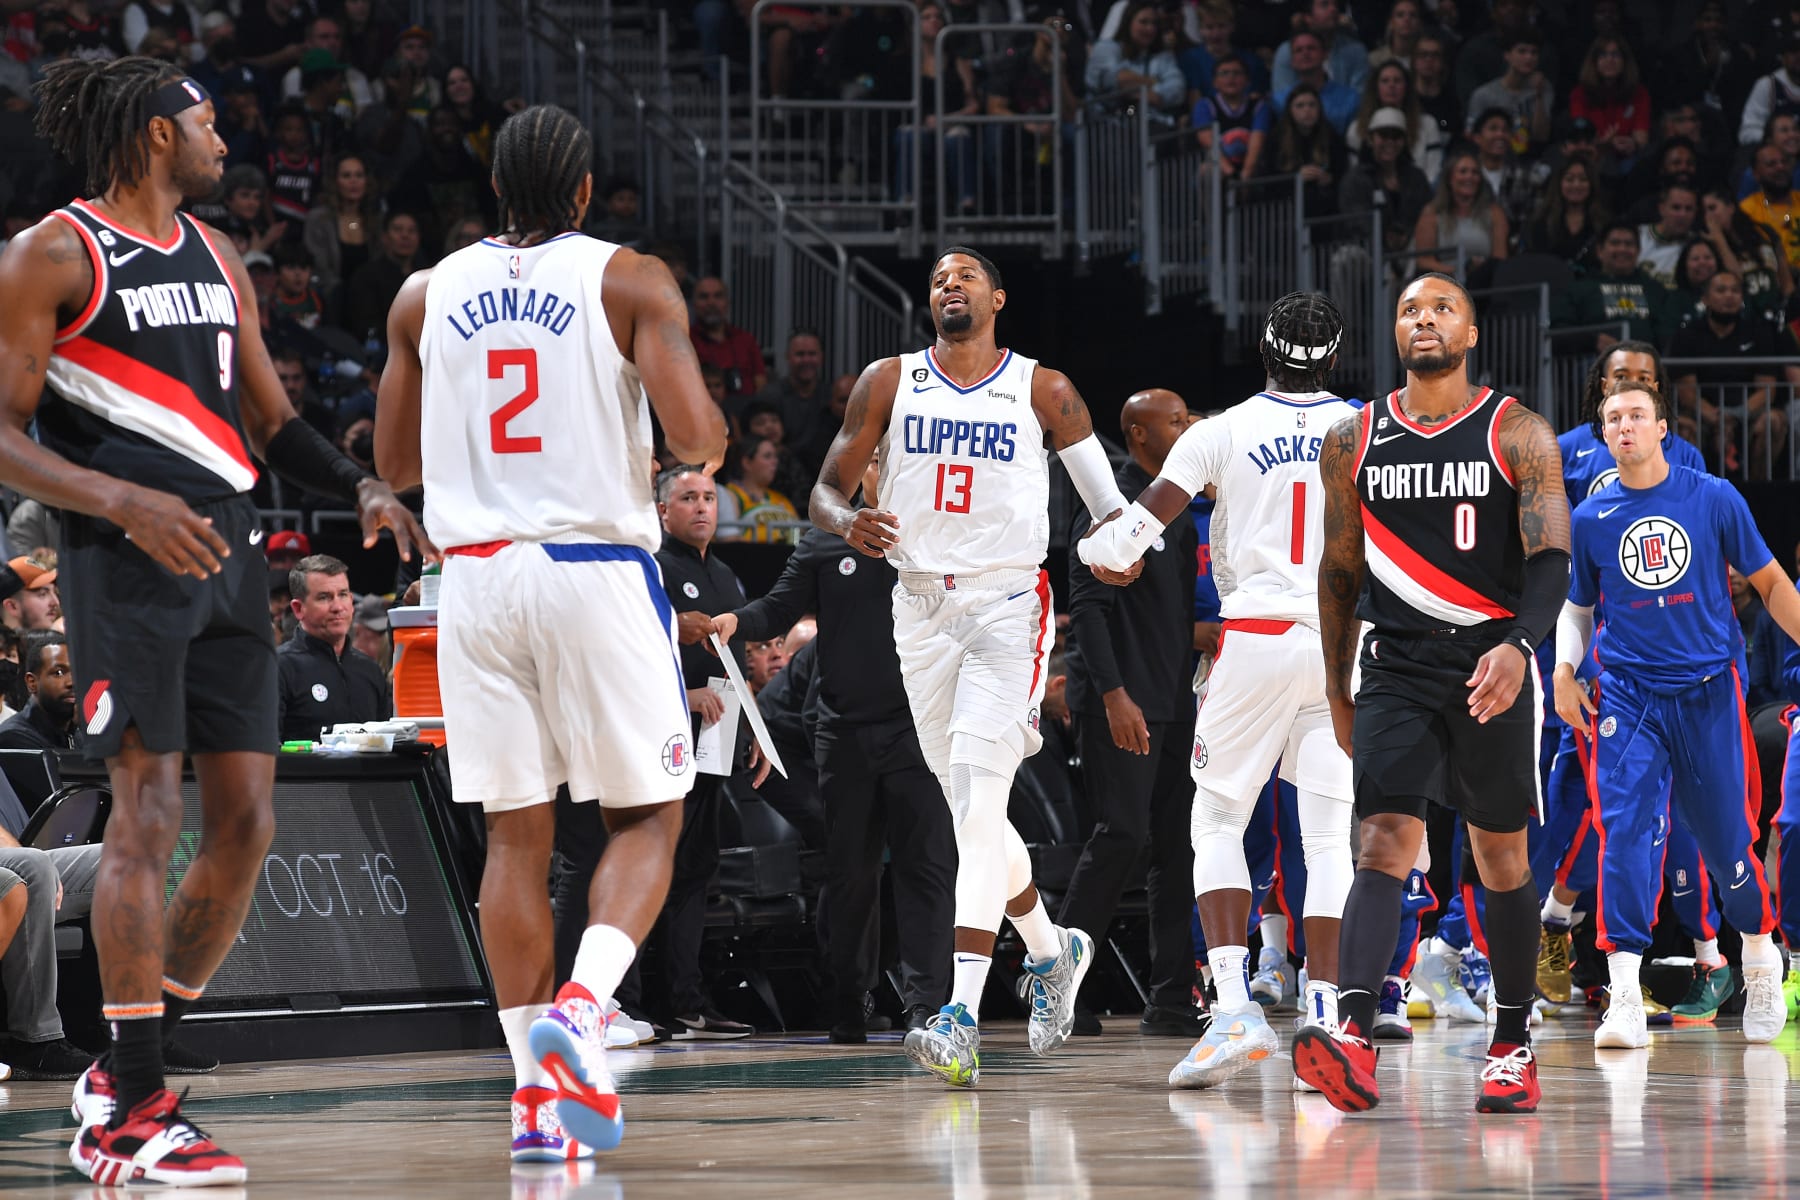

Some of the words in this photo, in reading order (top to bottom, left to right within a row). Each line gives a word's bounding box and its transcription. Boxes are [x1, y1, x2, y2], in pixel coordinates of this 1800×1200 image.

[97, 229, 117, 247] 6
[115, 281, 237, 332] PORTLAND
[446, 287, 576, 341] LEONARD
[217, 330, 234, 391] 9
[914, 369, 928, 382] 6
[487, 348, 542, 454] 2
[987, 388, 1017, 403] honey
[903, 414, 1017, 462] CLIPPERS
[1377, 416, 1389, 430] 6
[1248, 435, 1322, 476] JACKS
[934, 463, 974, 514] 13
[1364, 461, 1490, 502] PORTLAND
[1290, 481, 1306, 565] 1
[1454, 502, 1477, 551] 0
[265, 854, 363, 917] OCT.
[360, 853, 407, 916] 16
